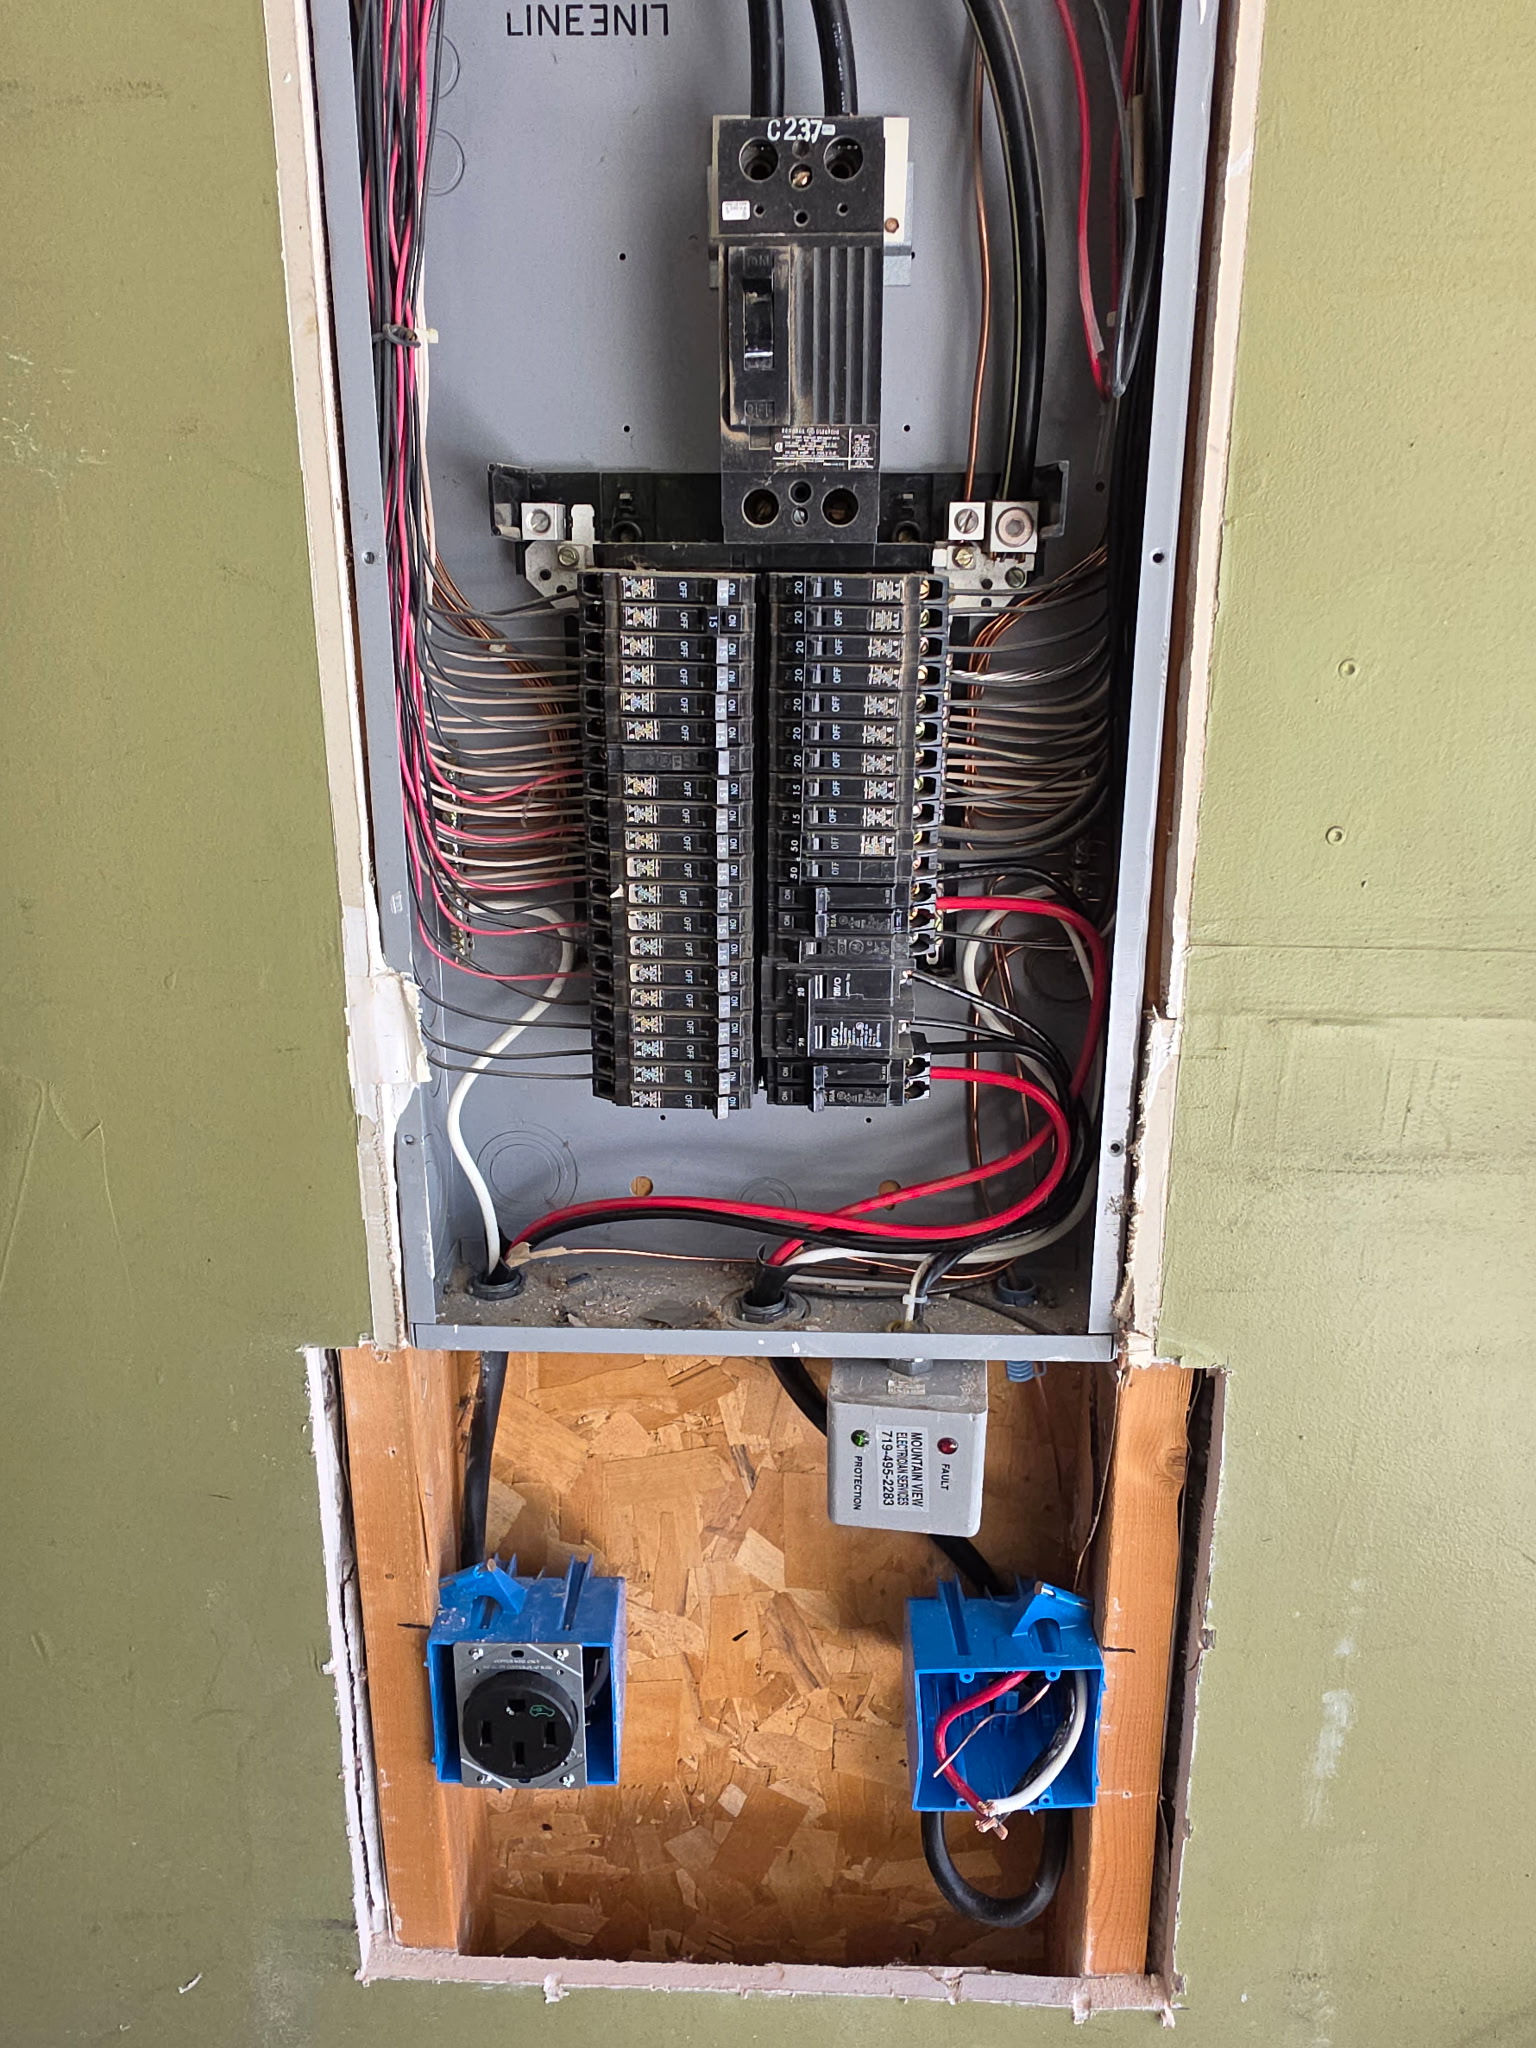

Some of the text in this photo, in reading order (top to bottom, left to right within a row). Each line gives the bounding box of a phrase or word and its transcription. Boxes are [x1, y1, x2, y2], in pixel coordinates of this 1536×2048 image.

[507, 4, 584, 36] LINE
[679, 581, 688, 598] OFF
[728, 582, 736, 596] ON
[794, 581, 803, 595] 20
[834, 579, 843, 597] OFF
[680, 612, 689, 629] OFF
[709, 616, 718, 628] 15
[728, 614, 737, 627] ON
[794, 610, 803, 625] 20
[834, 609, 843, 627] OFF
[680, 641, 688, 658] OFF
[728, 643, 737, 656] ON
[795, 640, 804, 654] 20
[834, 638, 843, 656] OFF
[680, 668, 688, 685] OFF
[794, 668, 803, 682] 20
[833, 666, 841, 684] OFF
[680, 697, 689, 714] OFF
[728, 699, 737, 712] ON
[793, 698, 802, 712] 20
[831, 696, 840, 713] OFF
[681, 725, 690, 741] OFF
[728, 726, 737, 739] ON
[792, 727, 801, 740] 20
[832, 724, 841, 741] OFF
[793, 754, 802, 768] 20
[832, 752, 840, 768] OFF
[683, 781, 692, 797] OFF
[730, 783, 738, 795] ON
[792, 784, 801, 795] 15
[832, 780, 840, 796] OFF
[682, 808, 690, 824] OFF
[729, 810, 737, 822] ON
[792, 813, 800, 824] 15
[828, 808, 837, 823] OFF
[683, 836, 692, 852] OFF
[730, 838, 738, 850] ON
[790, 840, 799, 852] 50
[684, 862, 692, 878] OFF
[730, 864, 738, 877] ON
[790, 867, 798, 880] 50
[679, 890, 688, 905] OFF
[784, 889, 791, 900] ON
[683, 916, 692, 932] OFF
[730, 918, 737, 930] ON
[783, 915, 790, 926] ON
[684, 942, 693, 957] OFF
[730, 943, 738, 955] ON
[685, 969, 693, 984] OFF
[730, 971, 738, 982] ON
[685, 993, 694, 1009] OFF
[730, 995, 739, 1007] ON
[686, 1020, 694, 1035] OFF
[731, 1022, 739, 1034] ON
[686, 1045, 695, 1060] OFF
[731, 1047, 739, 1058] ON
[684, 1069, 693, 1084] OFF
[782, 1066, 789, 1077] ON
[685, 1094, 693, 1108] OFF
[728, 1096, 737, 1107] ON
[781, 1091, 788, 1101] ON
[882, 1430, 894, 1506] 719-495-2283
[911, 1432, 924, 1507] MOUNTAIN VIEW
[853, 1455, 863, 1510] PROTECTION
[941, 1463, 950, 1491] FAULT
[897, 1475, 909, 1506] SERVICES
